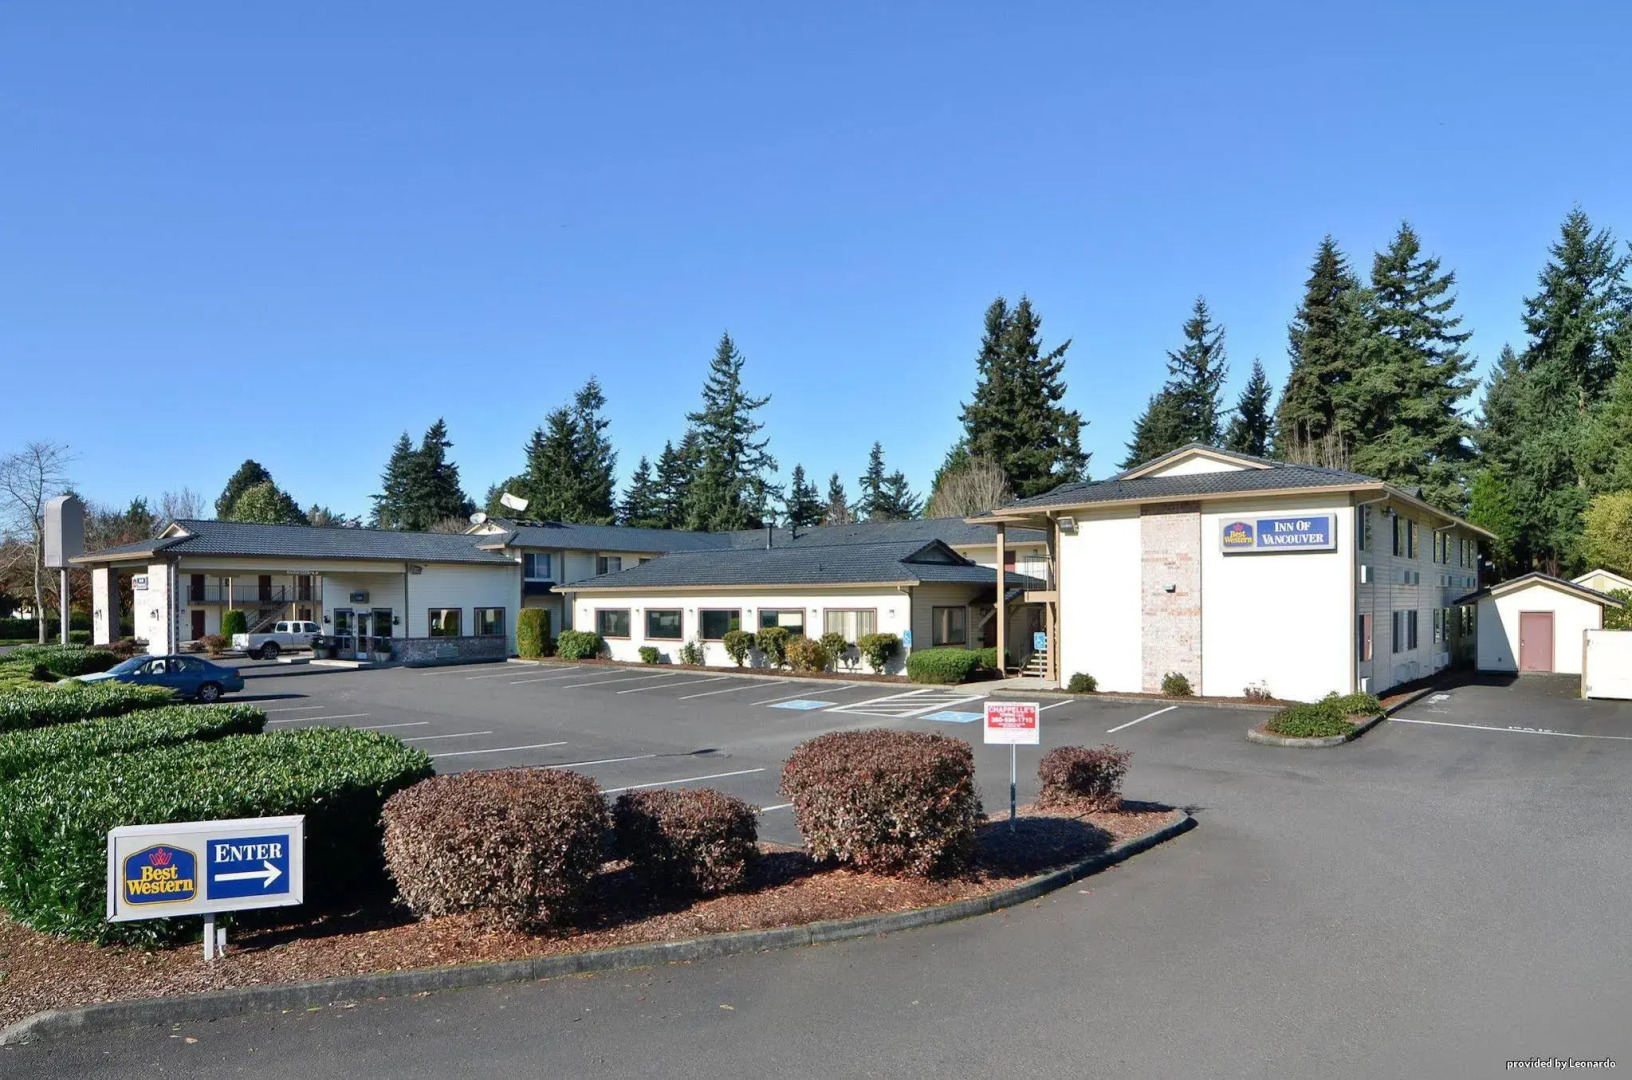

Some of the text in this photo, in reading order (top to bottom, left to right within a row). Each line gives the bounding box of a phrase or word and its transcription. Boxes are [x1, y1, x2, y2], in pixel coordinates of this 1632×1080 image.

[1274, 520, 1311, 532] INN OF
[1224, 536, 1253, 544] Western
[1230, 530, 1246, 538] Best
[1262, 533, 1324, 545] VANCOUVER
[214, 842, 283, 863] ENTER
[141, 864, 178, 882] Best
[126, 878, 194, 895] Western
